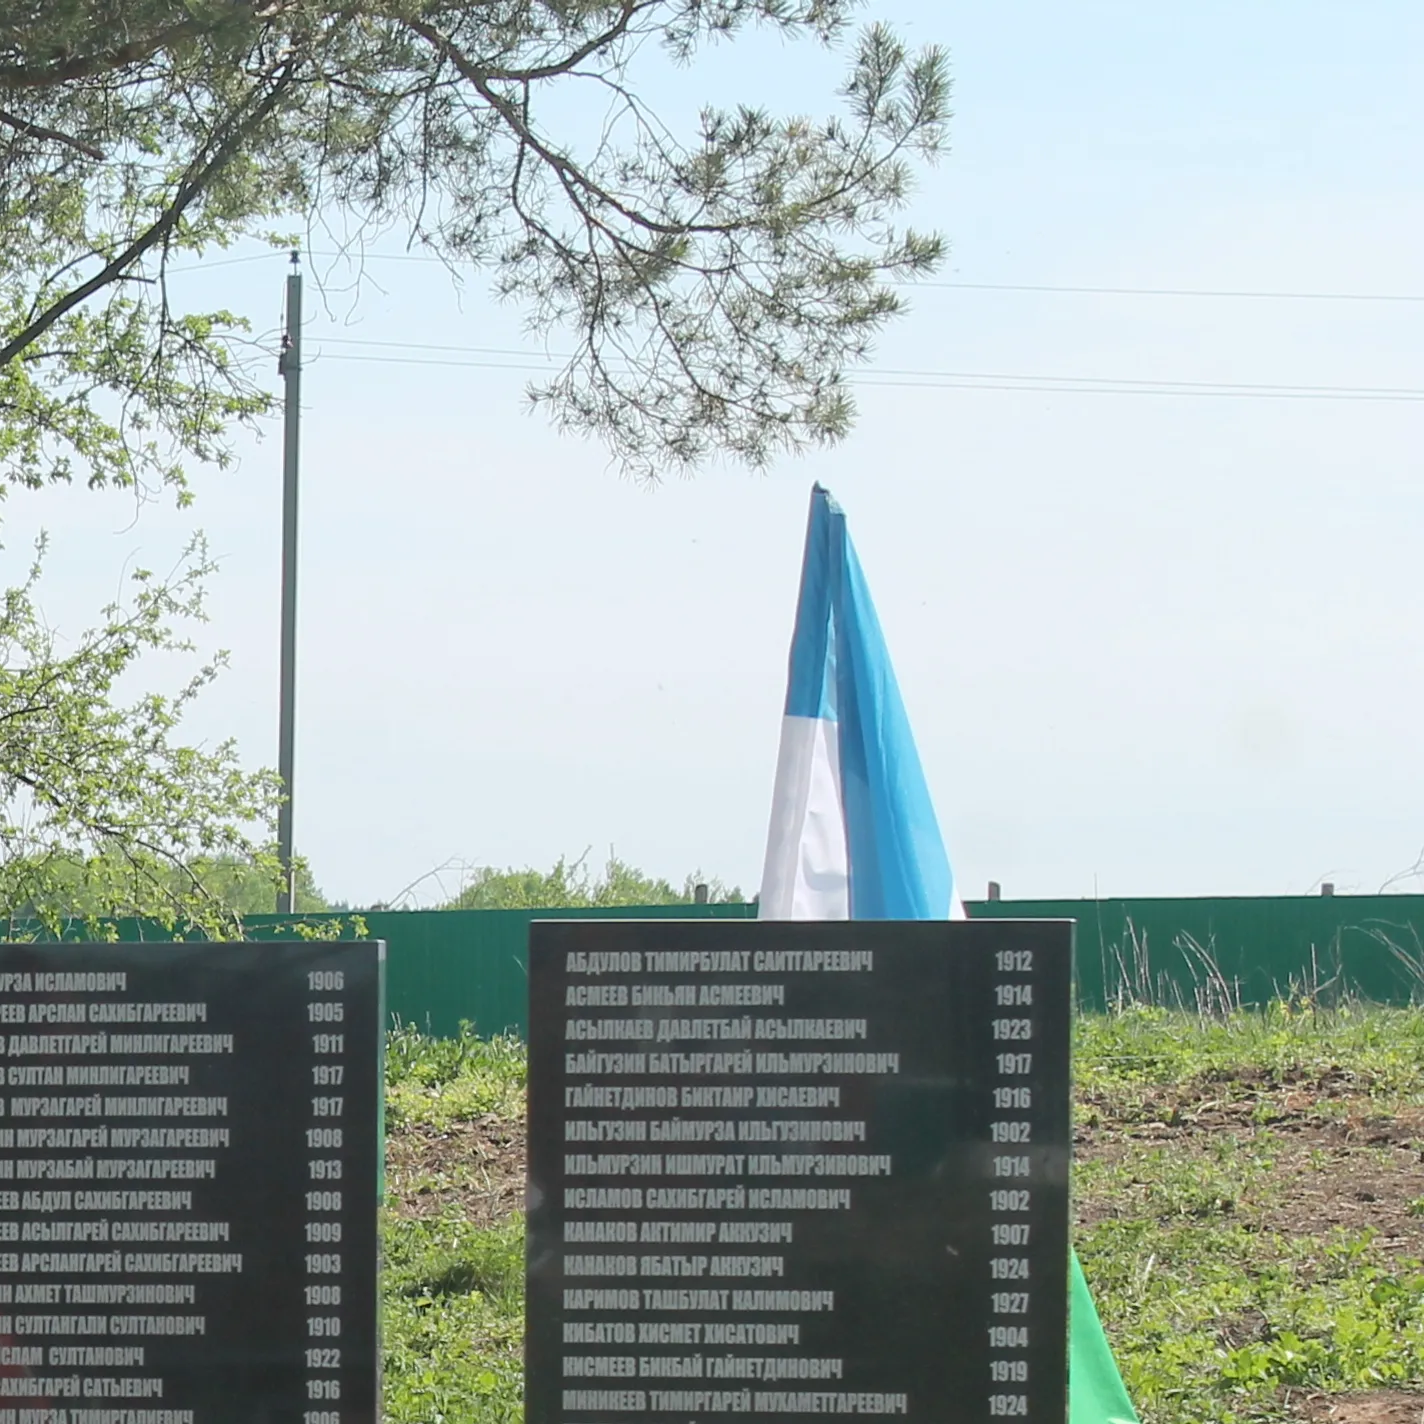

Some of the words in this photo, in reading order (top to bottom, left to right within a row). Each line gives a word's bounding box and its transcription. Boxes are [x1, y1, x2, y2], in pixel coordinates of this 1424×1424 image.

[996, 950, 1032, 971] 1912
[308, 970, 344, 990] 1906
[308, 1002, 343, 1021] 1905
[992, 1018, 1032, 1039] 1923
[994, 1087, 1031, 1108] 1916
[306, 1191, 342, 1210] 1908
[991, 1189, 1029, 1211] 1902
[305, 1285, 341, 1304] 1908
[992, 1292, 1028, 1313] 1927
[991, 1361, 1028, 1381] 1919
